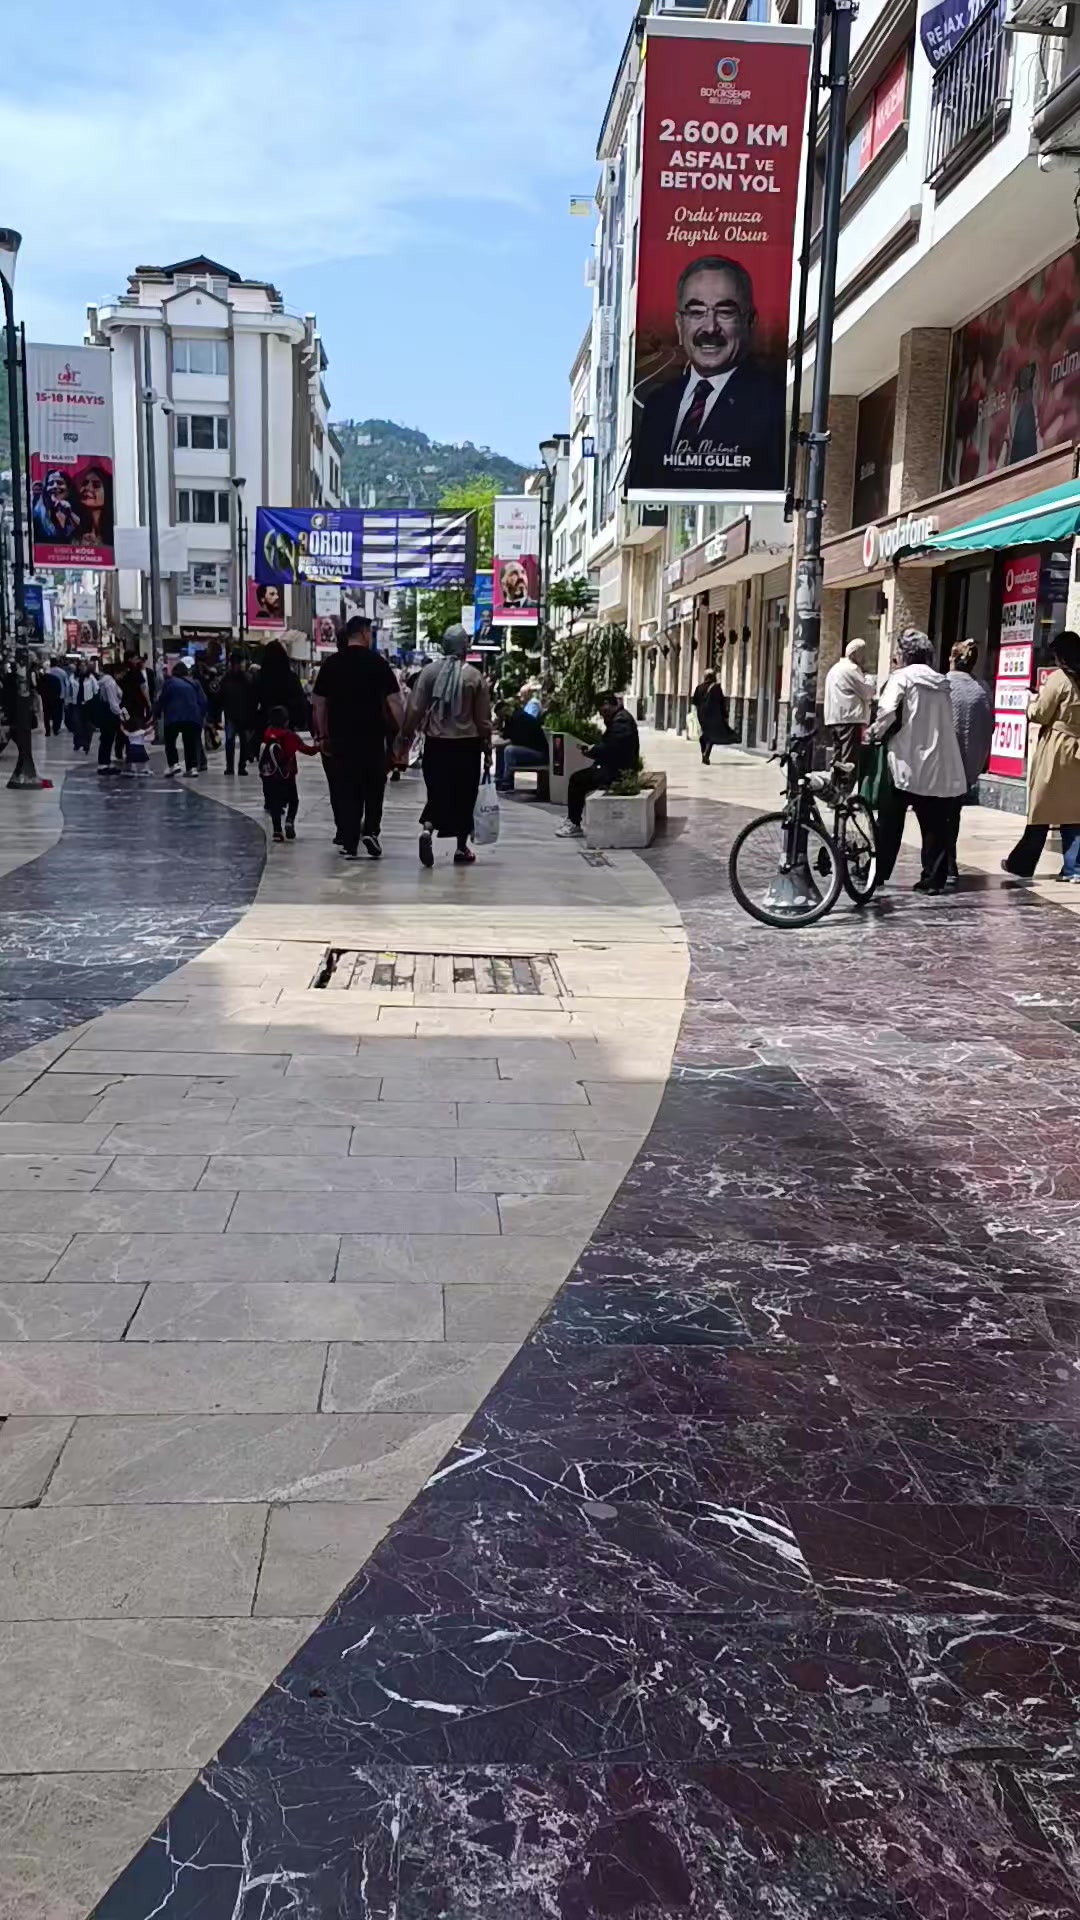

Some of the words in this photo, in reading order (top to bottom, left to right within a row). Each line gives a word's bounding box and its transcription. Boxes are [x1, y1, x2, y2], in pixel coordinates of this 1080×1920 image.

[659, 118, 739, 145] 2.600
[746, 124, 788, 147] KM
[669, 150, 750, 170] ASFALT
[755, 159, 774, 171] VE
[660, 171, 733, 191] BETON
[739, 174, 781, 193] YOL
[725, 226, 769, 242] Olsun
[310, 530, 352, 556] ORDU
